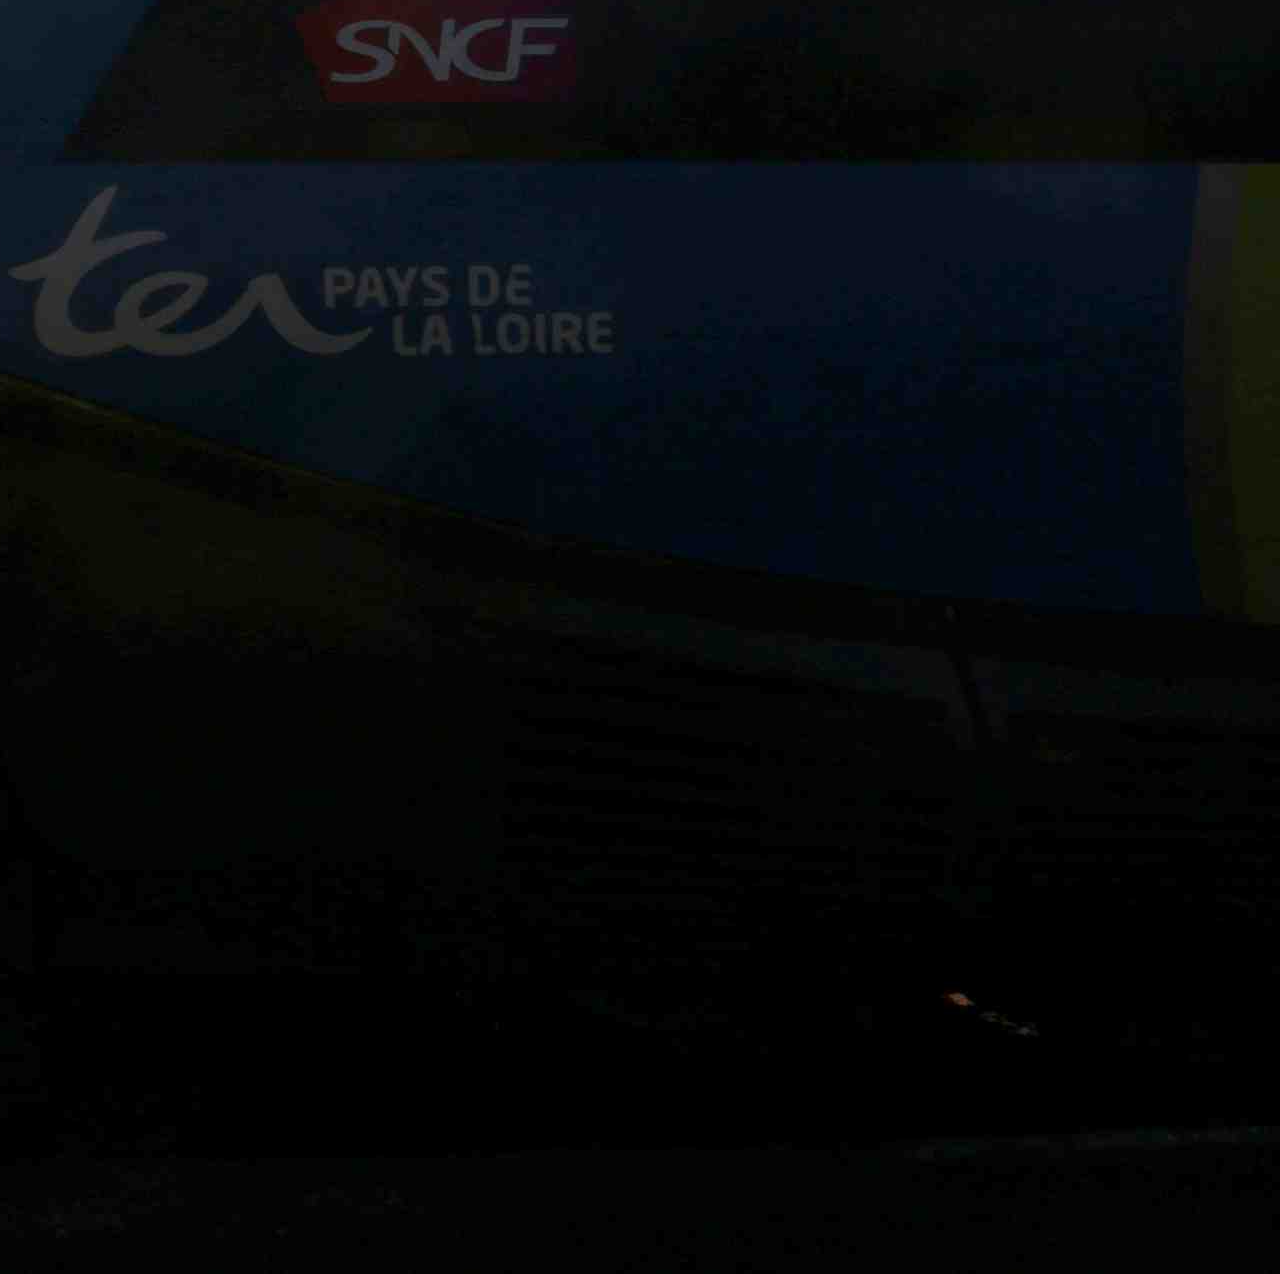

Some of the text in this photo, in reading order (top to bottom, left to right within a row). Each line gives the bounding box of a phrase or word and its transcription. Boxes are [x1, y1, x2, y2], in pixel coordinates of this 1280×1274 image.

[331, 17, 569, 83] SNCF
[8, 185, 372, 356] ter
[323, 264, 533, 309] PAYS DE
[392, 312, 614, 356] LA LOIRE
